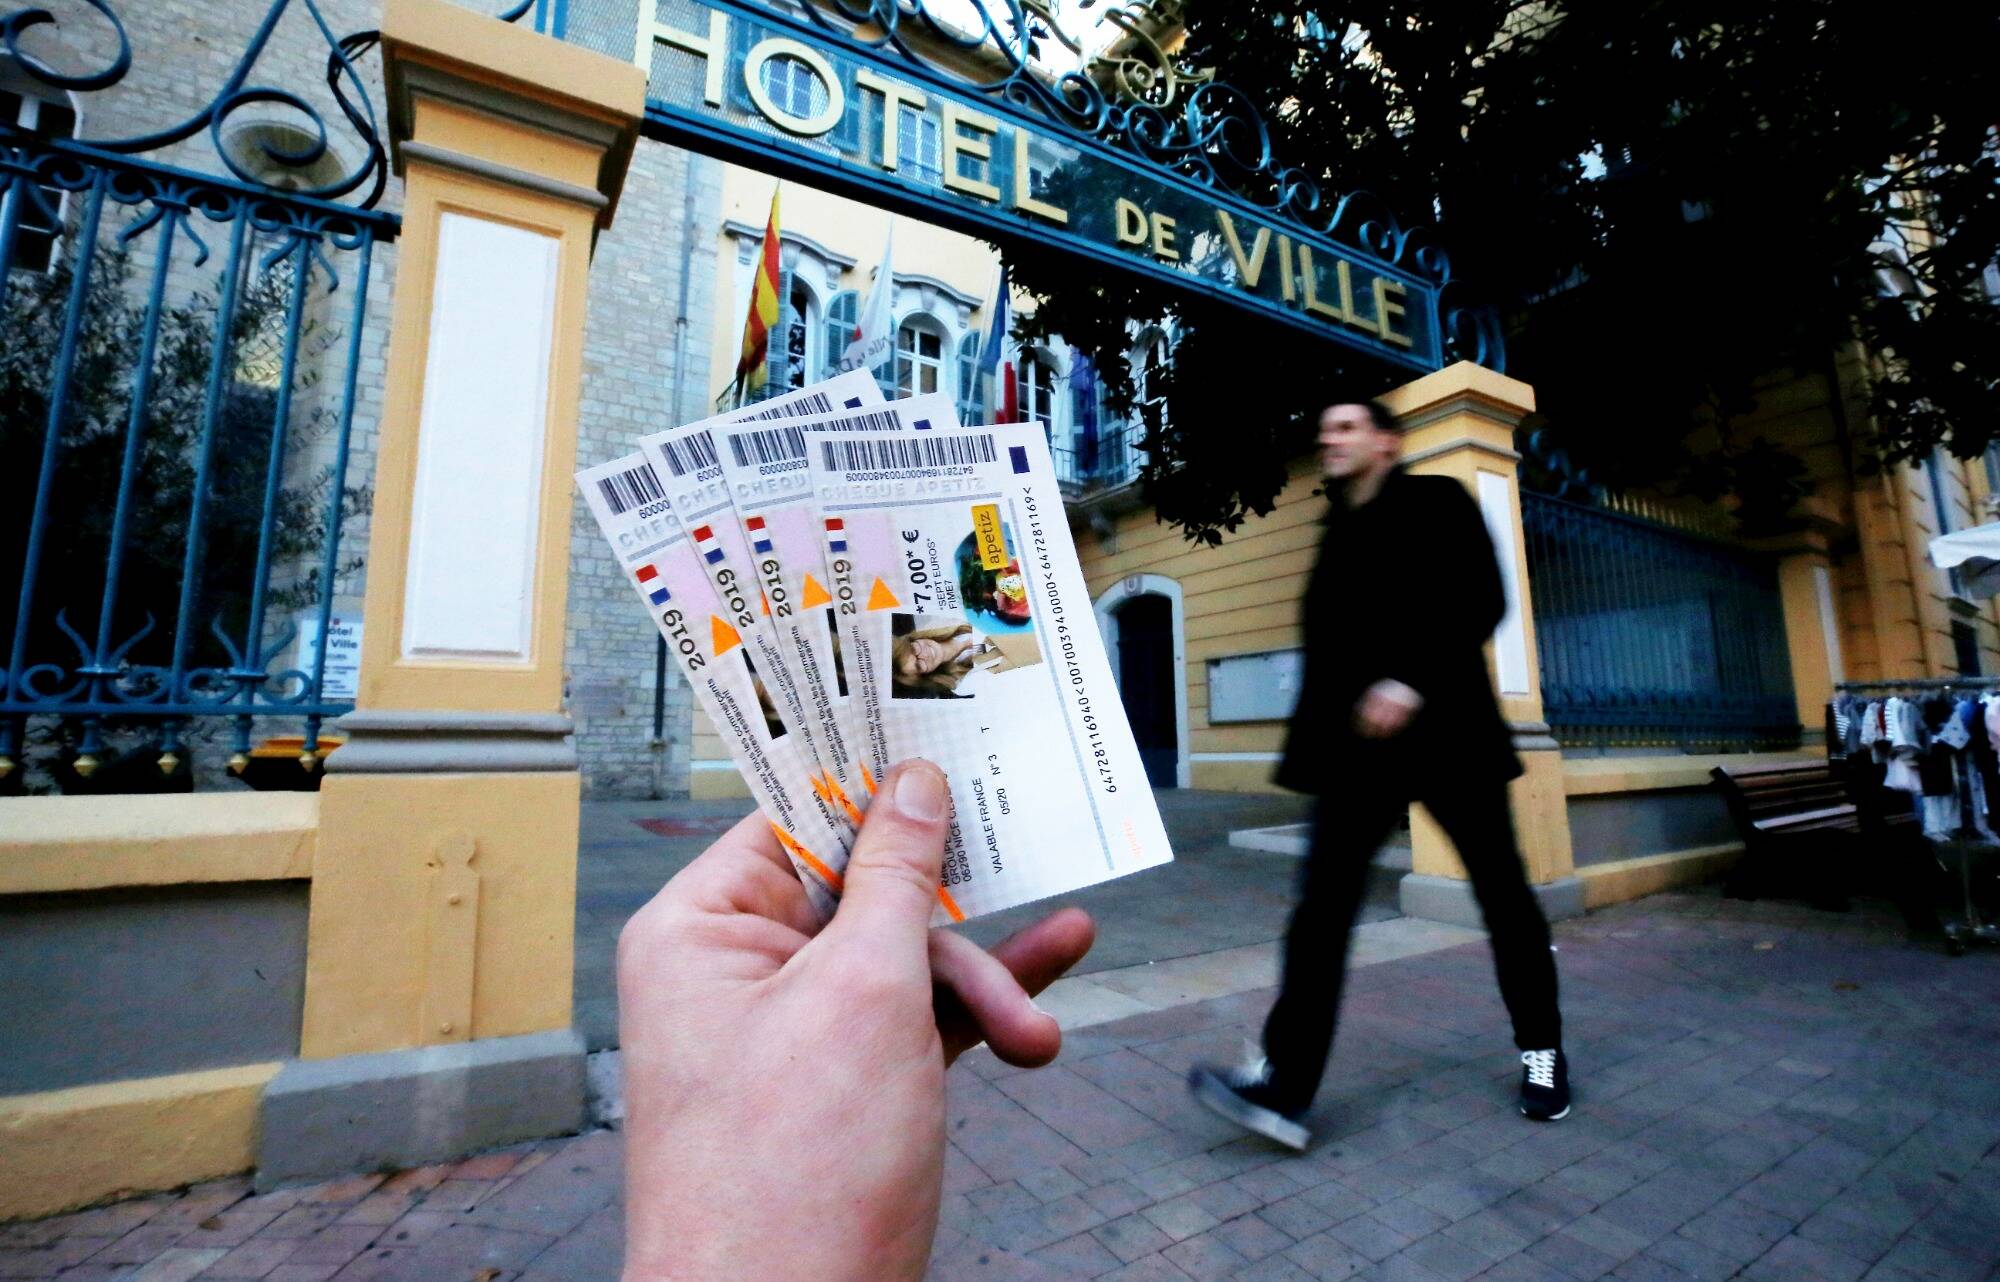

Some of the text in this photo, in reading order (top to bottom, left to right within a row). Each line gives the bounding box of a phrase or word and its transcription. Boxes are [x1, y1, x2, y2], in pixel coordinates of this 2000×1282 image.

[633, 0, 1414, 348] HOTEL DE VILLE
[979, 510, 1001, 564] apetiz
[716, 568, 756, 628] 2019
[762, 559, 793, 618] 2019
[833, 559, 857, 615] 2019
[663, 609, 706, 671] 2019
[981, 725, 989, 733] T
[972, 777, 1003, 873] VALABLE FRANCE
[996, 787, 1010, 815] 05/20
[949, 821, 972, 882] 06290 NICE
